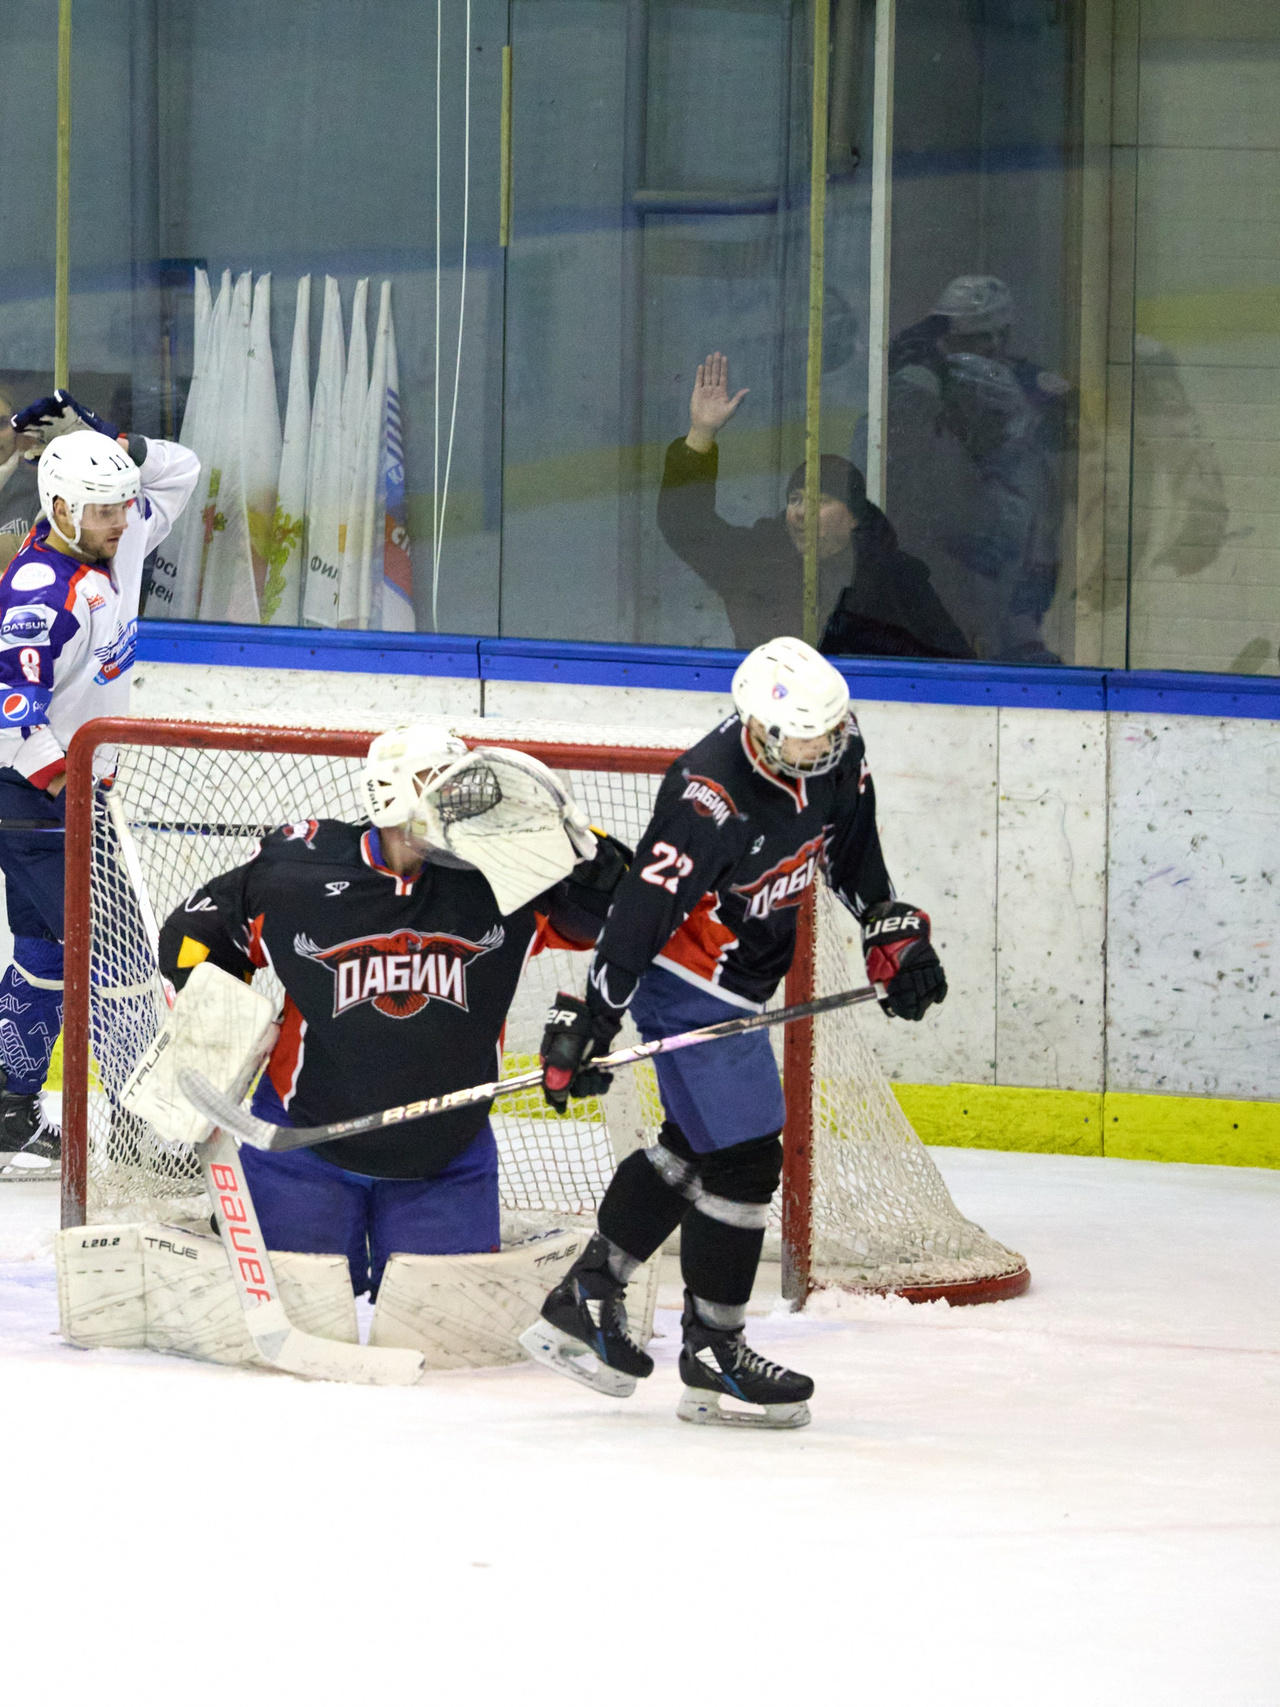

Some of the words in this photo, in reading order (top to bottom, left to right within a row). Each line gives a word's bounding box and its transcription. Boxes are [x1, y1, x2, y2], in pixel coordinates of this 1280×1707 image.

[1, 621, 49, 634] DATSUN
[124, 1031, 171, 1100] TRUE
[144, 1236, 199, 1260] TRUE
[533, 1243, 578, 1268] TRUE
